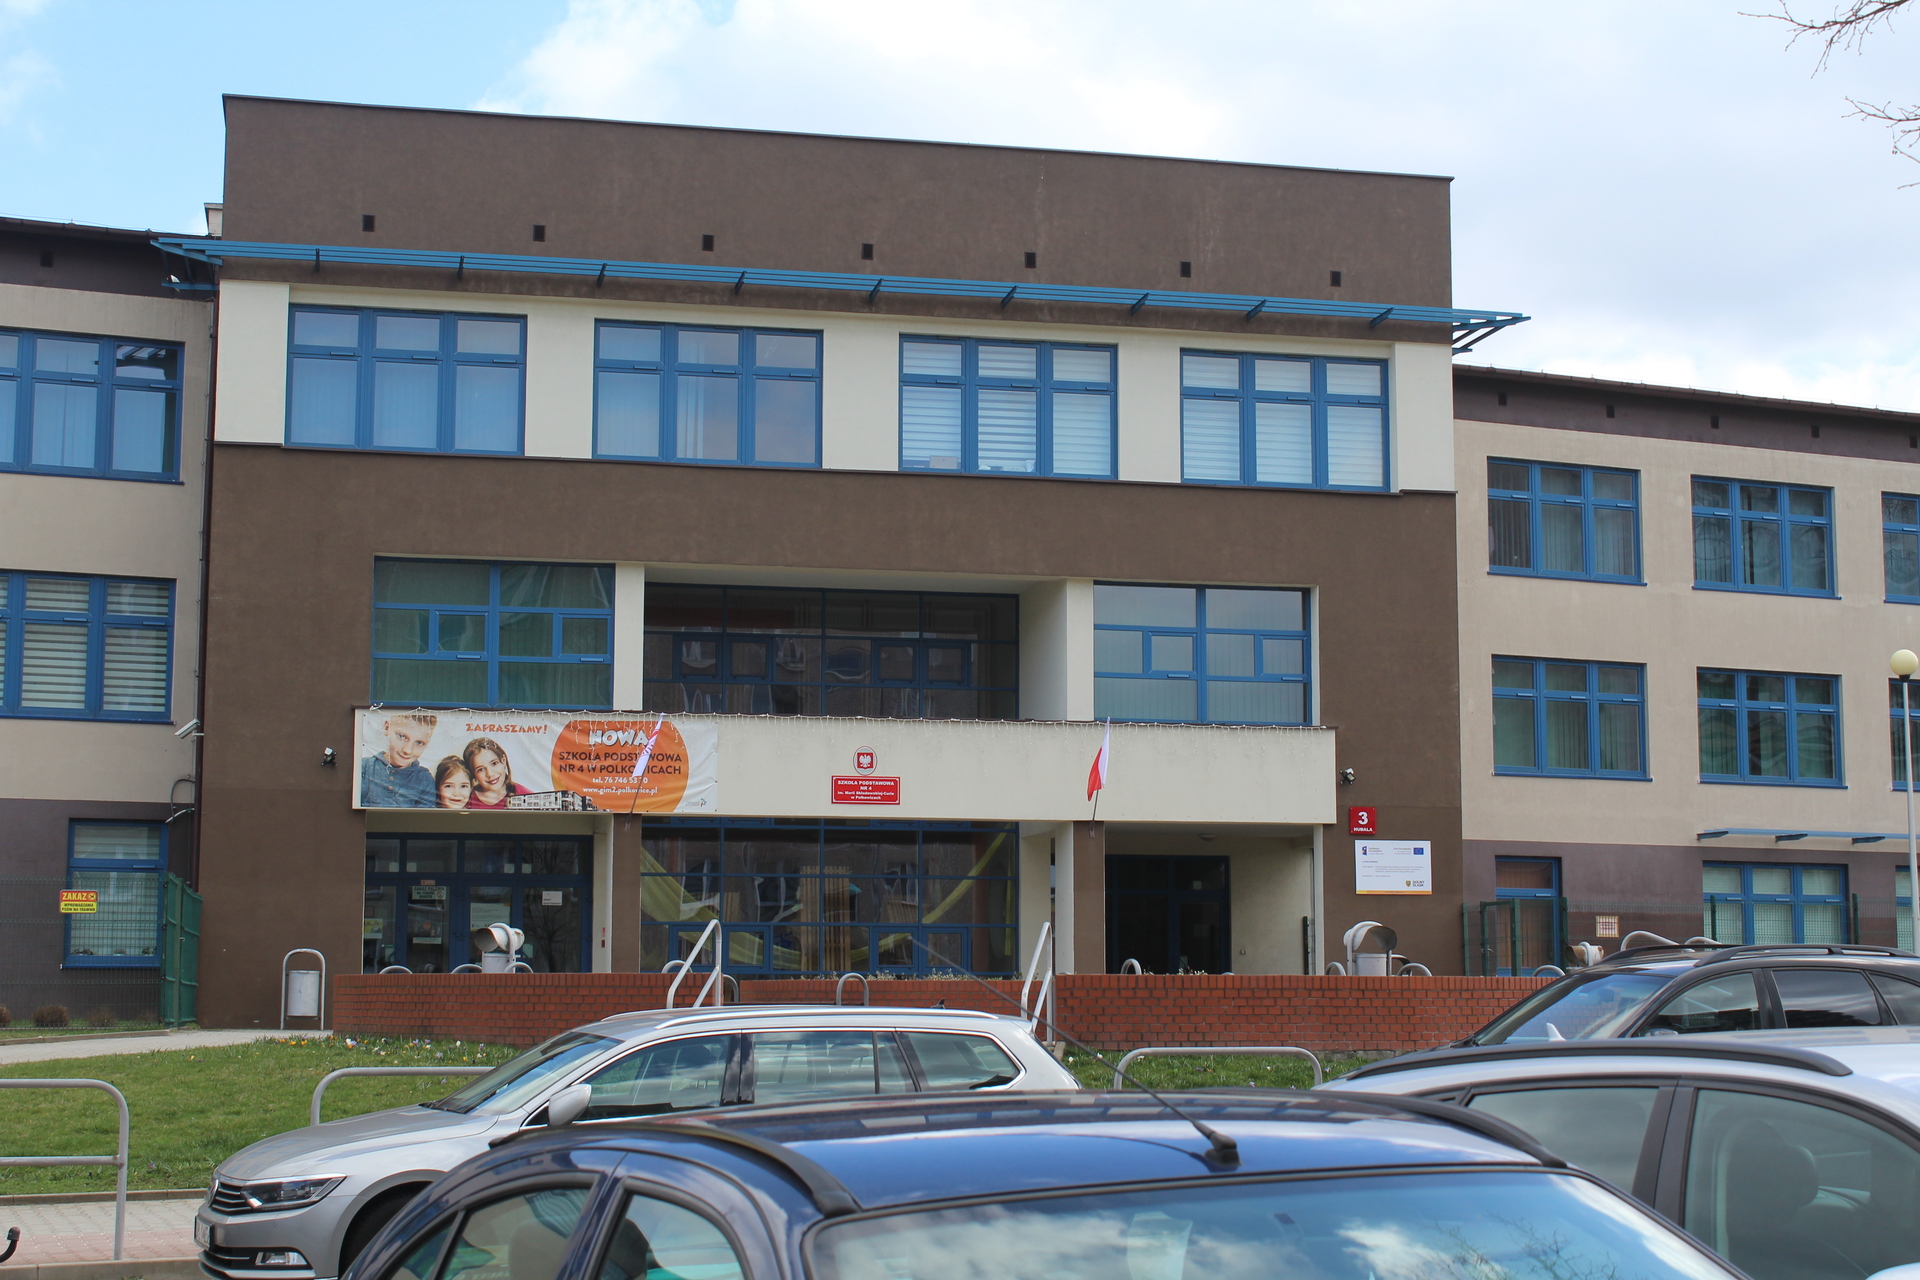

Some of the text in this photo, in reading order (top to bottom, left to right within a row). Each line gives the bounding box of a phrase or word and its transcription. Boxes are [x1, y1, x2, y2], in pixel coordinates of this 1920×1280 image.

[466, 723, 548, 734] ZAPRASZAMY!
[589, 729, 649, 746] NOWA
[559, 751, 682, 762] SZKOŁA PODSTWOWA
[559, 764, 681, 775] NR 4 W POLKOICACH
[592, 776, 603, 784] tel.
[1358, 811, 1369, 825] 3
